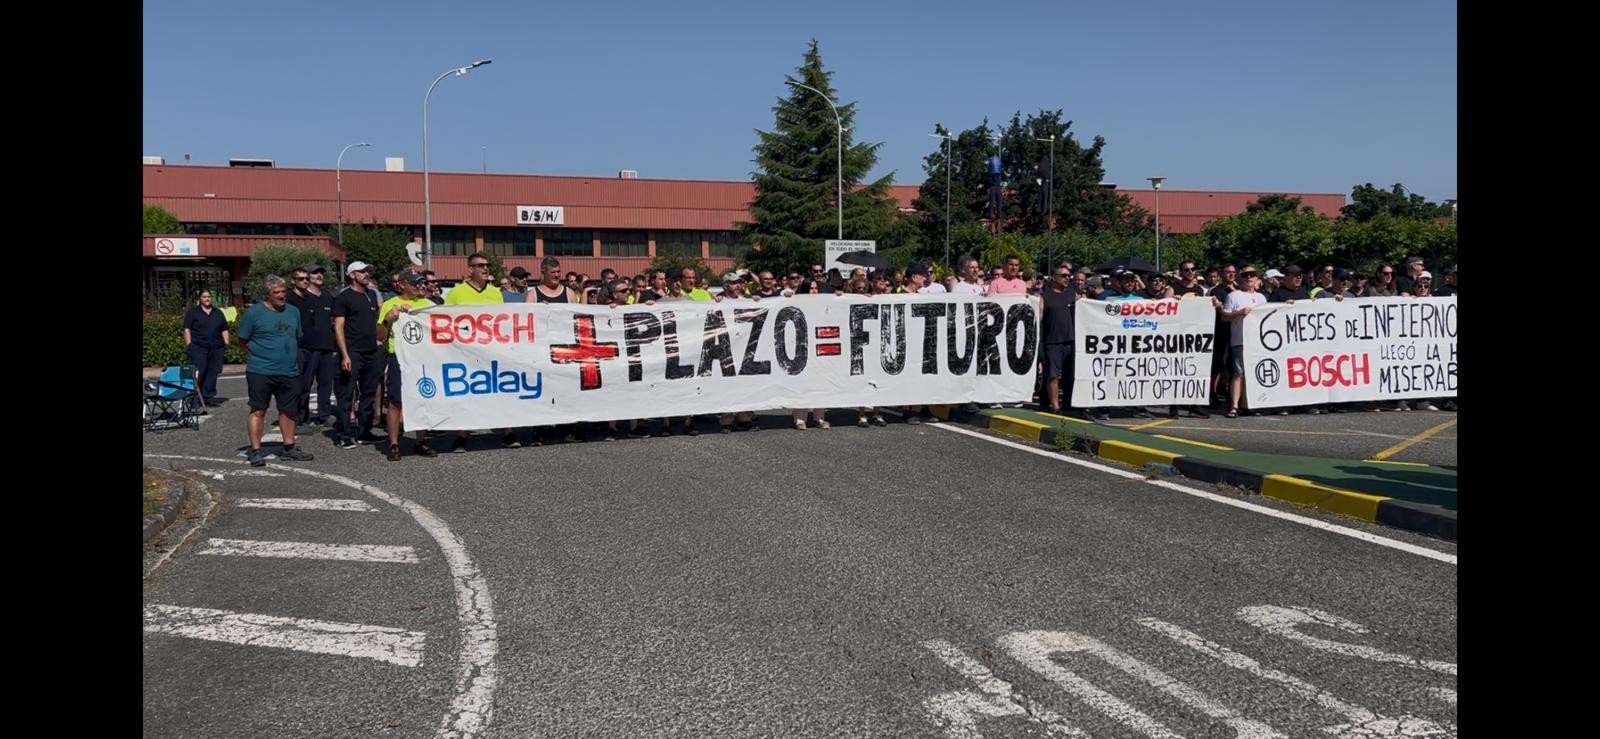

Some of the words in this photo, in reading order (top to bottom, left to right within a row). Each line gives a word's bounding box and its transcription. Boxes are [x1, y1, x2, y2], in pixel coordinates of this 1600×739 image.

[521, 209, 559, 223] B/S/H/
[1120, 302, 1178, 316] BOSCH
[429, 312, 535, 345] BOSCH
[1260, 309, 1282, 351] 6
[1286, 313, 1336, 344] MESES
[1345, 319, 1359, 338] DE
[1358, 303, 1457, 340] INFIERNO
[623, 306, 808, 382] PLAZO
[849, 302, 1038, 376] FUTURO
[1085, 335, 1127, 354] BSH
[1131, 333, 1213, 354] ESQUIROZ
[1380, 341, 1416, 361] LLEGÓ
[1426, 343, 1441, 362] LA
[1092, 356, 1197, 378] OFFSHORING
[1287, 353, 1370, 388] BOSCH
[441, 360, 543, 400] Balay
[1092, 380, 1106, 401] IS
[1117, 380, 1150, 400] NOT
[1152, 379, 1206, 400] OPTION
